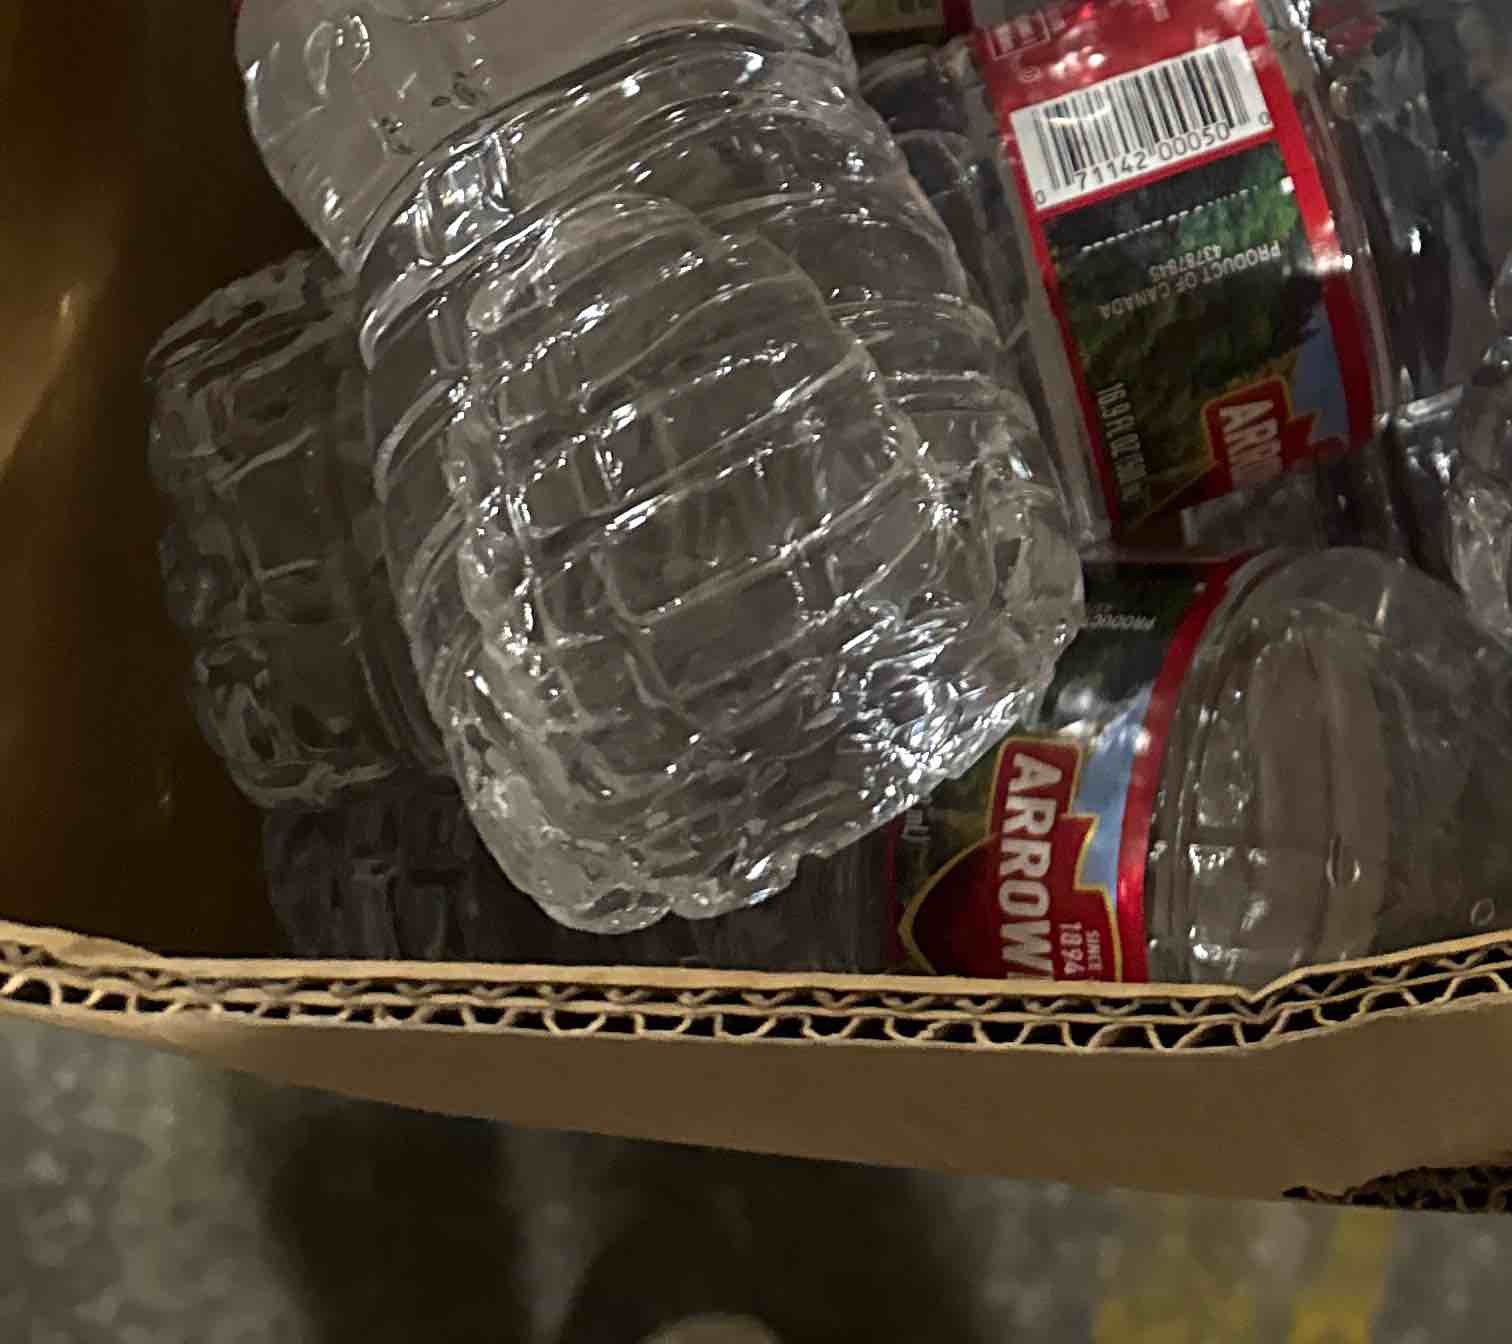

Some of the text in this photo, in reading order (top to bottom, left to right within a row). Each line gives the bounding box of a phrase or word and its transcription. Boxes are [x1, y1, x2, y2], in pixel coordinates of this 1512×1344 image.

[1073, 152, 1149, 192] 71142
[1157, 121, 1232, 163] 00050
[1200, 239, 1282, 283] PRODUCT
[1099, 281, 1171, 321] CANADA
[1003, 751, 1064, 982] ARROW
[1057, 921, 1083, 977] 1894
